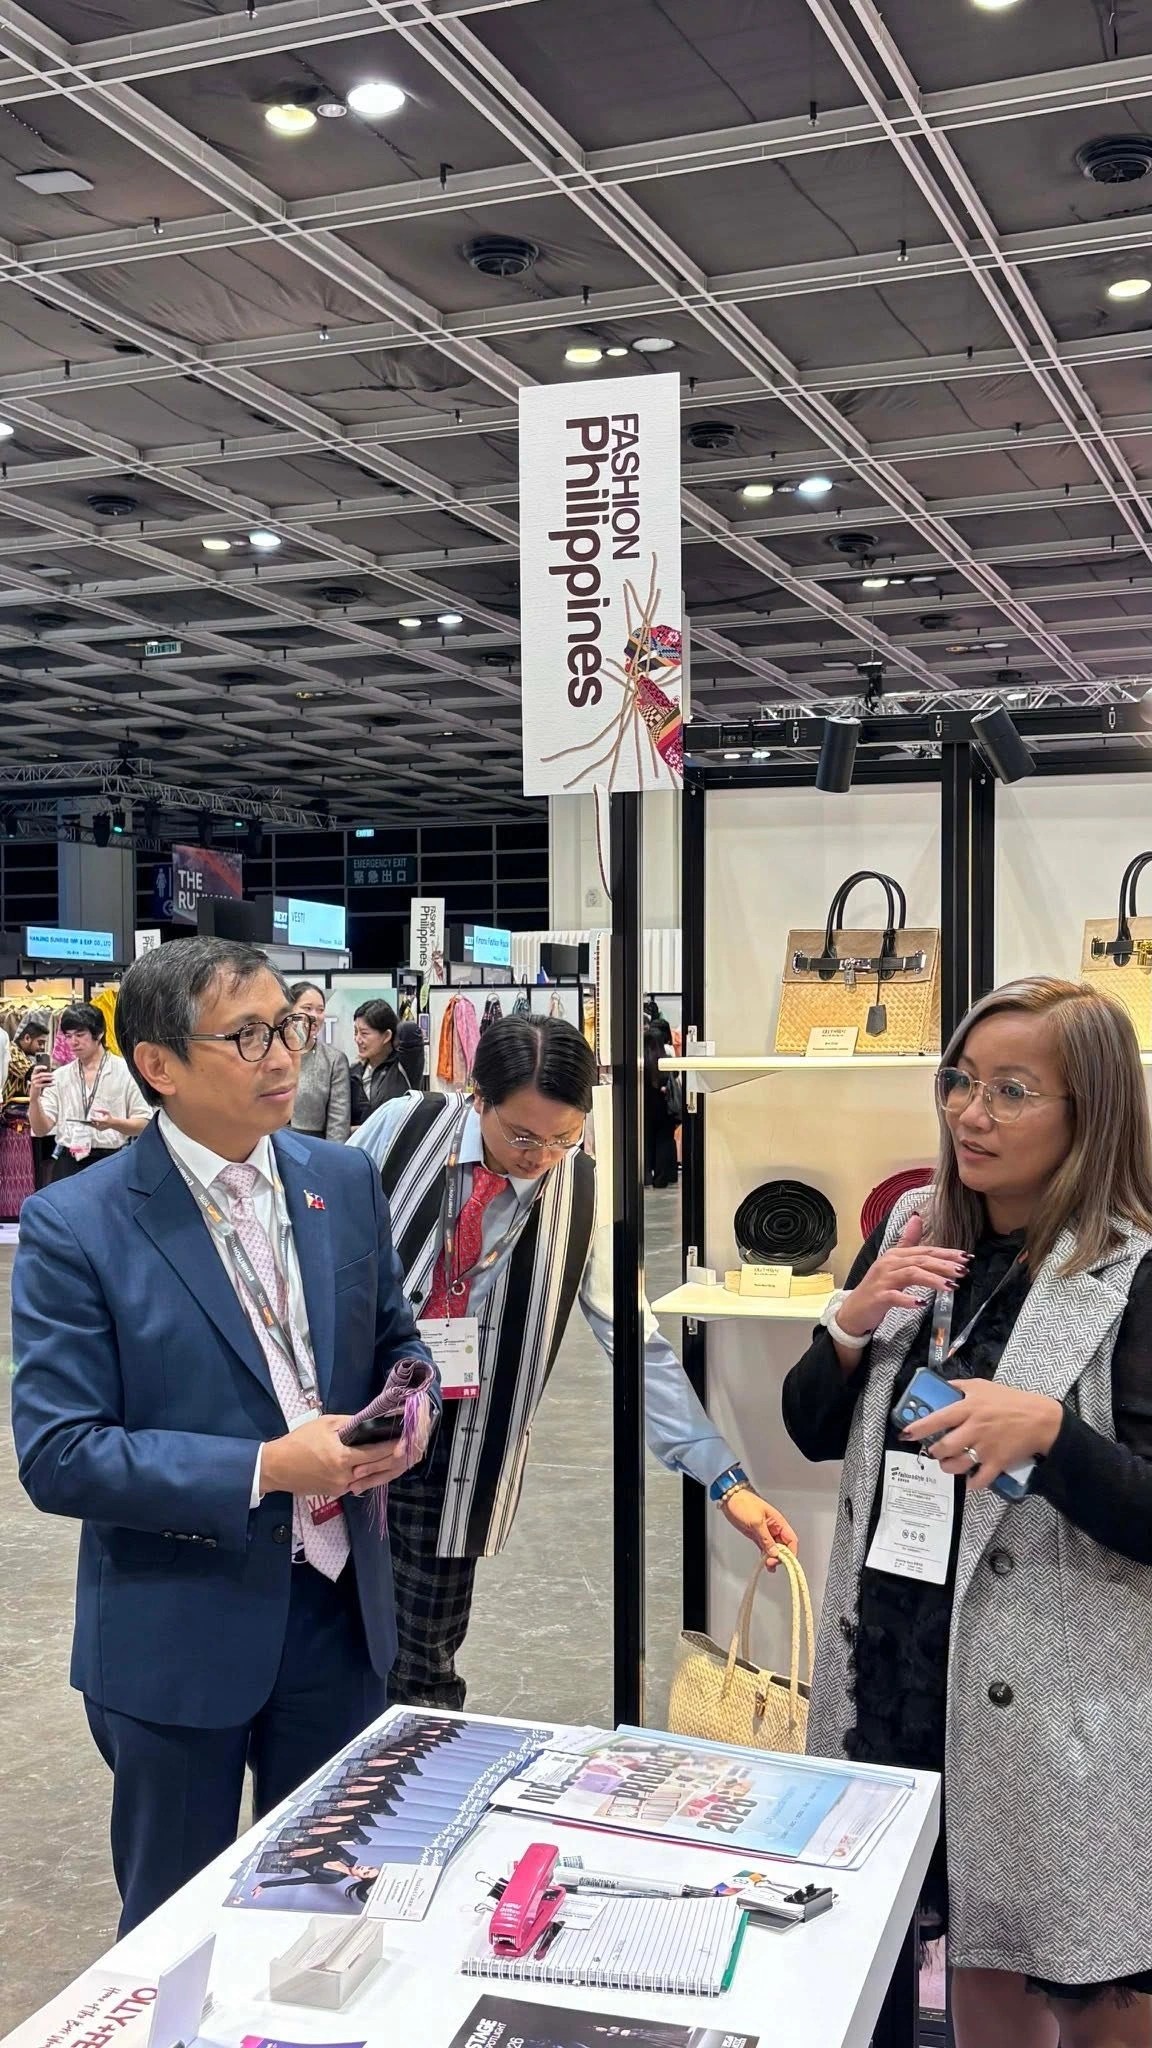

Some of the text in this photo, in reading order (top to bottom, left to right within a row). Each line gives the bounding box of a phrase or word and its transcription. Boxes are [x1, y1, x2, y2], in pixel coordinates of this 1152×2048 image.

[610, 412, 640, 561] FASHION
[548, 415, 610, 709] Philippines
[178, 869, 203, 890] THE
[416, 905, 430, 967] Philippines
[429, 905, 437, 937] FASHION
[696, 1791, 758, 1834] 2026
[484, 2021, 507, 2048] POTLIGHT
